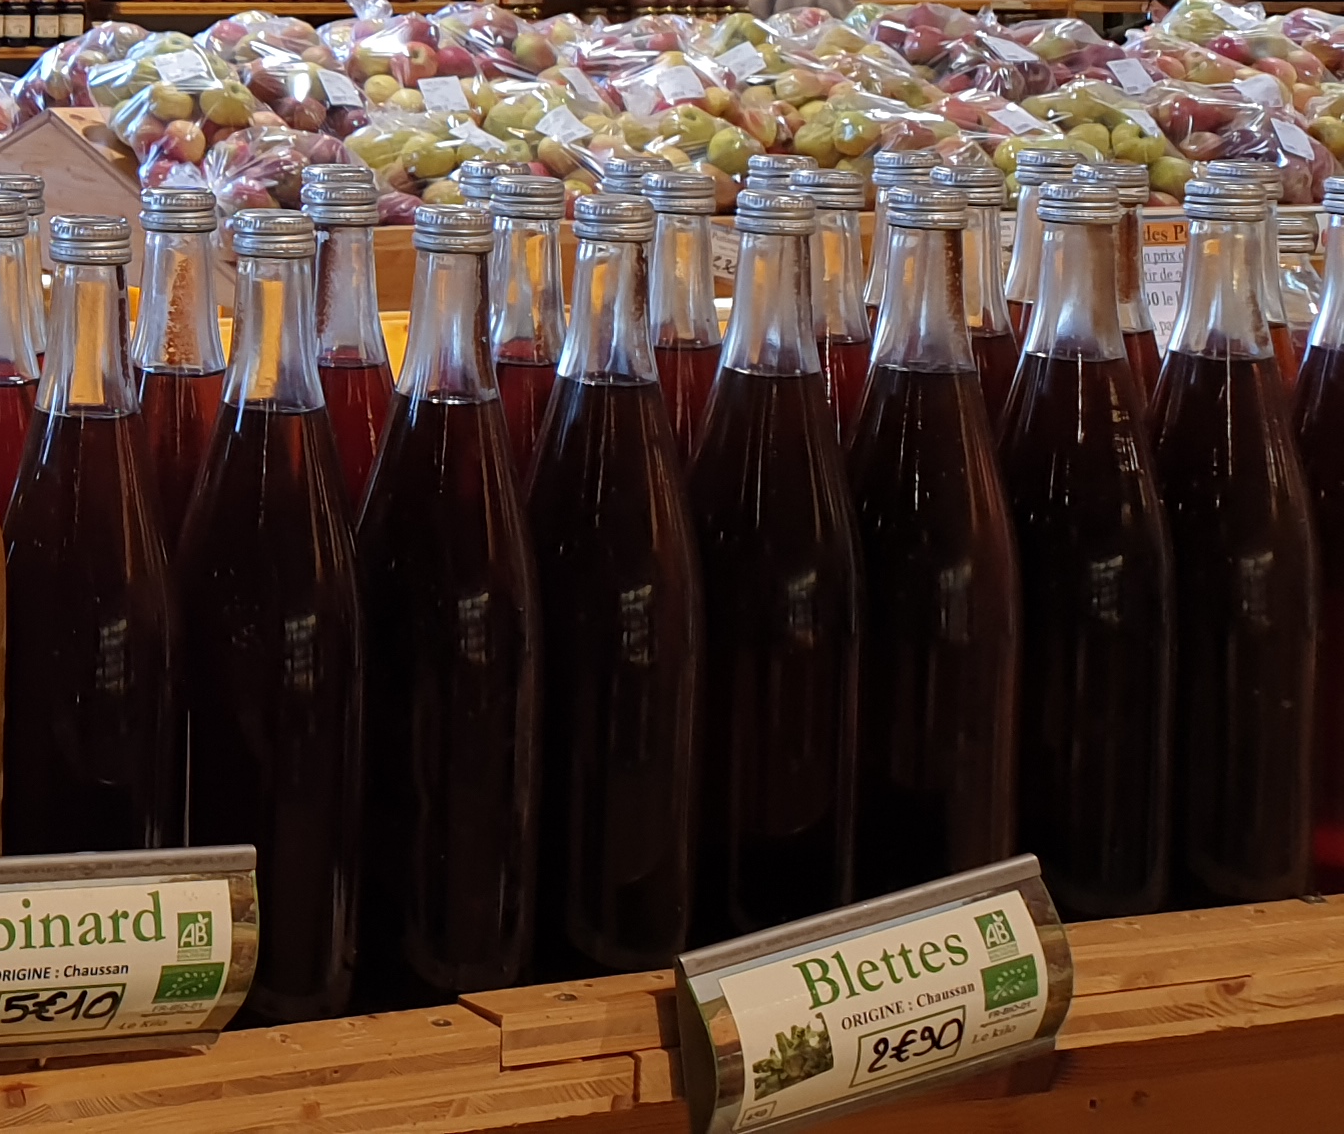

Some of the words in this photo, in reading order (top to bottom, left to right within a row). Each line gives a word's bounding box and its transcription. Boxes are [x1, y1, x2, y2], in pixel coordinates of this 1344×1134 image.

[180, 922, 208, 947] AB
[986, 922, 1010, 947] AB
[63, 964, 129, 978] Chaussan
[792, 934, 969, 1010] Blettes
[0, 990, 120, 1024] 5€10
[841, 1001, 905, 1030] ORIGINE
[916, 983, 976, 1008] Chaussan
[867, 1018, 964, 1073] 2€90
